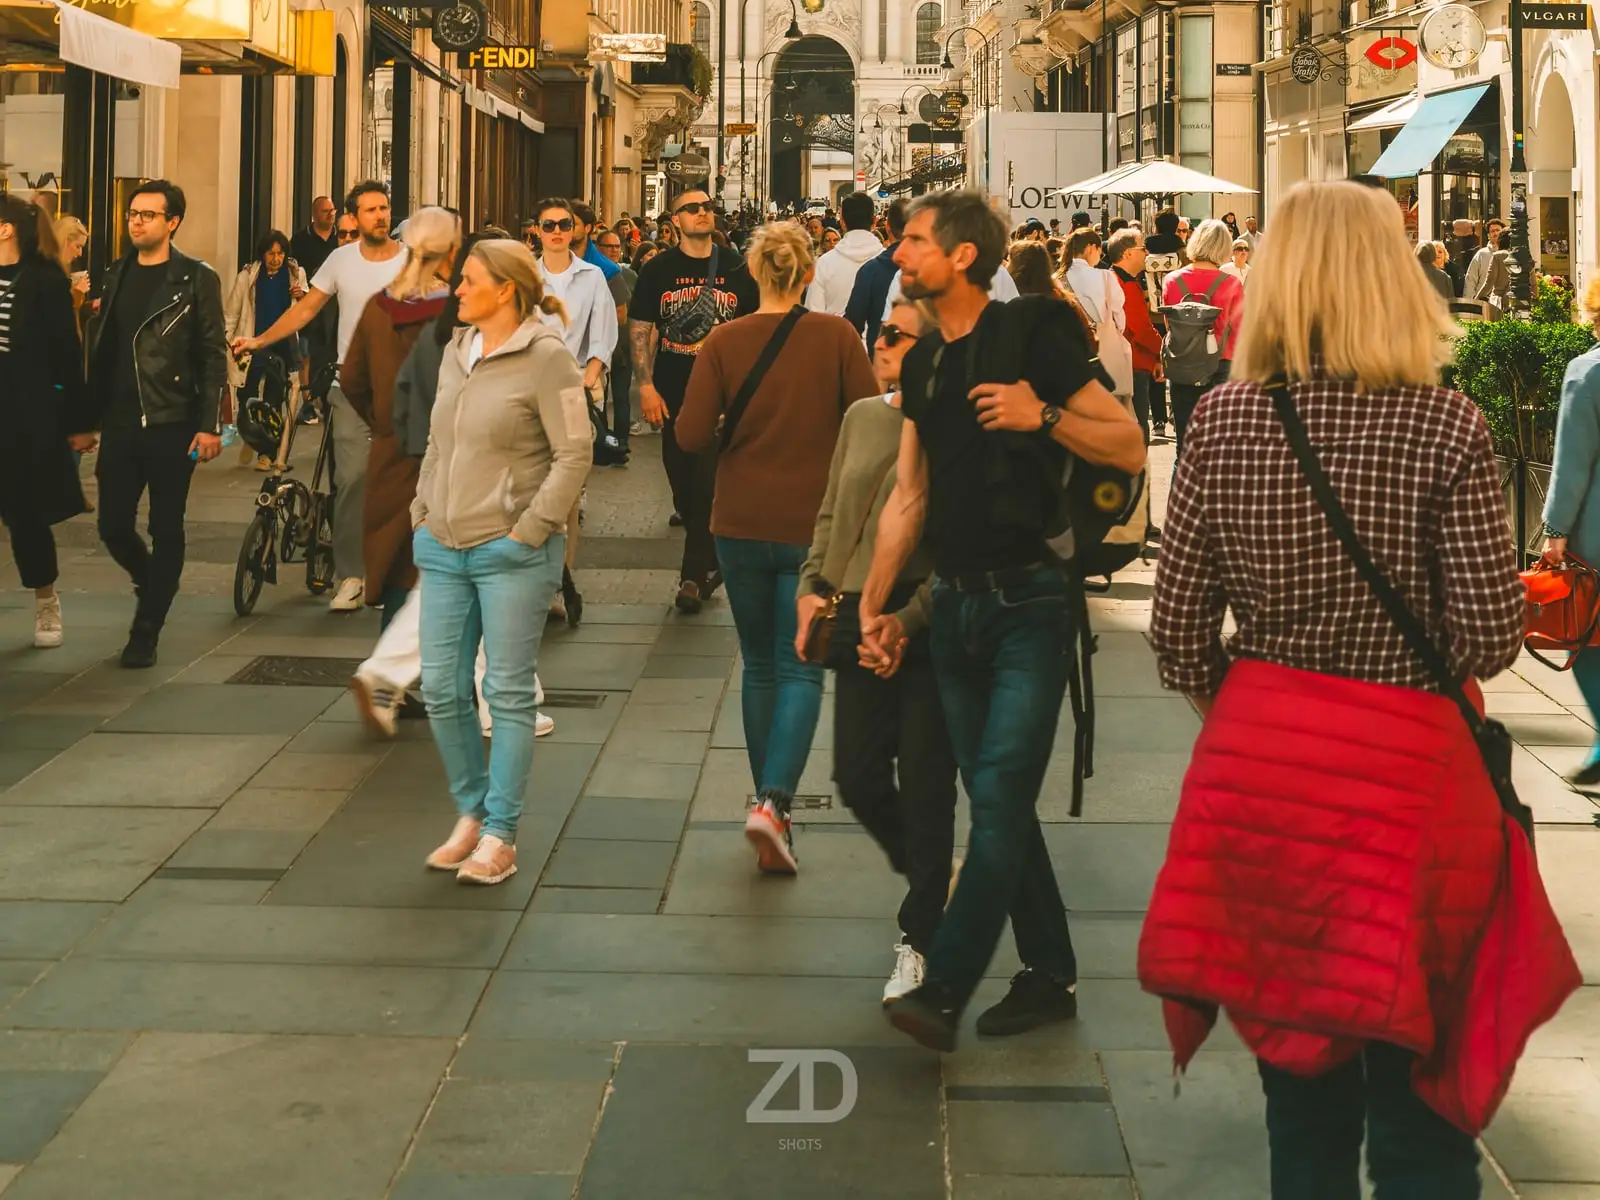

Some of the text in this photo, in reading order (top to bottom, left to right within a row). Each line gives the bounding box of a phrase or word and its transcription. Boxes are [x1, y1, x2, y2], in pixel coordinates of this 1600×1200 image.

[1522, 11, 1584, 21] VLGARI
[469, 47, 535, 68] FENDI
[1293, 54, 1318, 66] Tabak
[698, 277, 725, 285] WLD
[660, 285, 738, 321] CHAMNS
